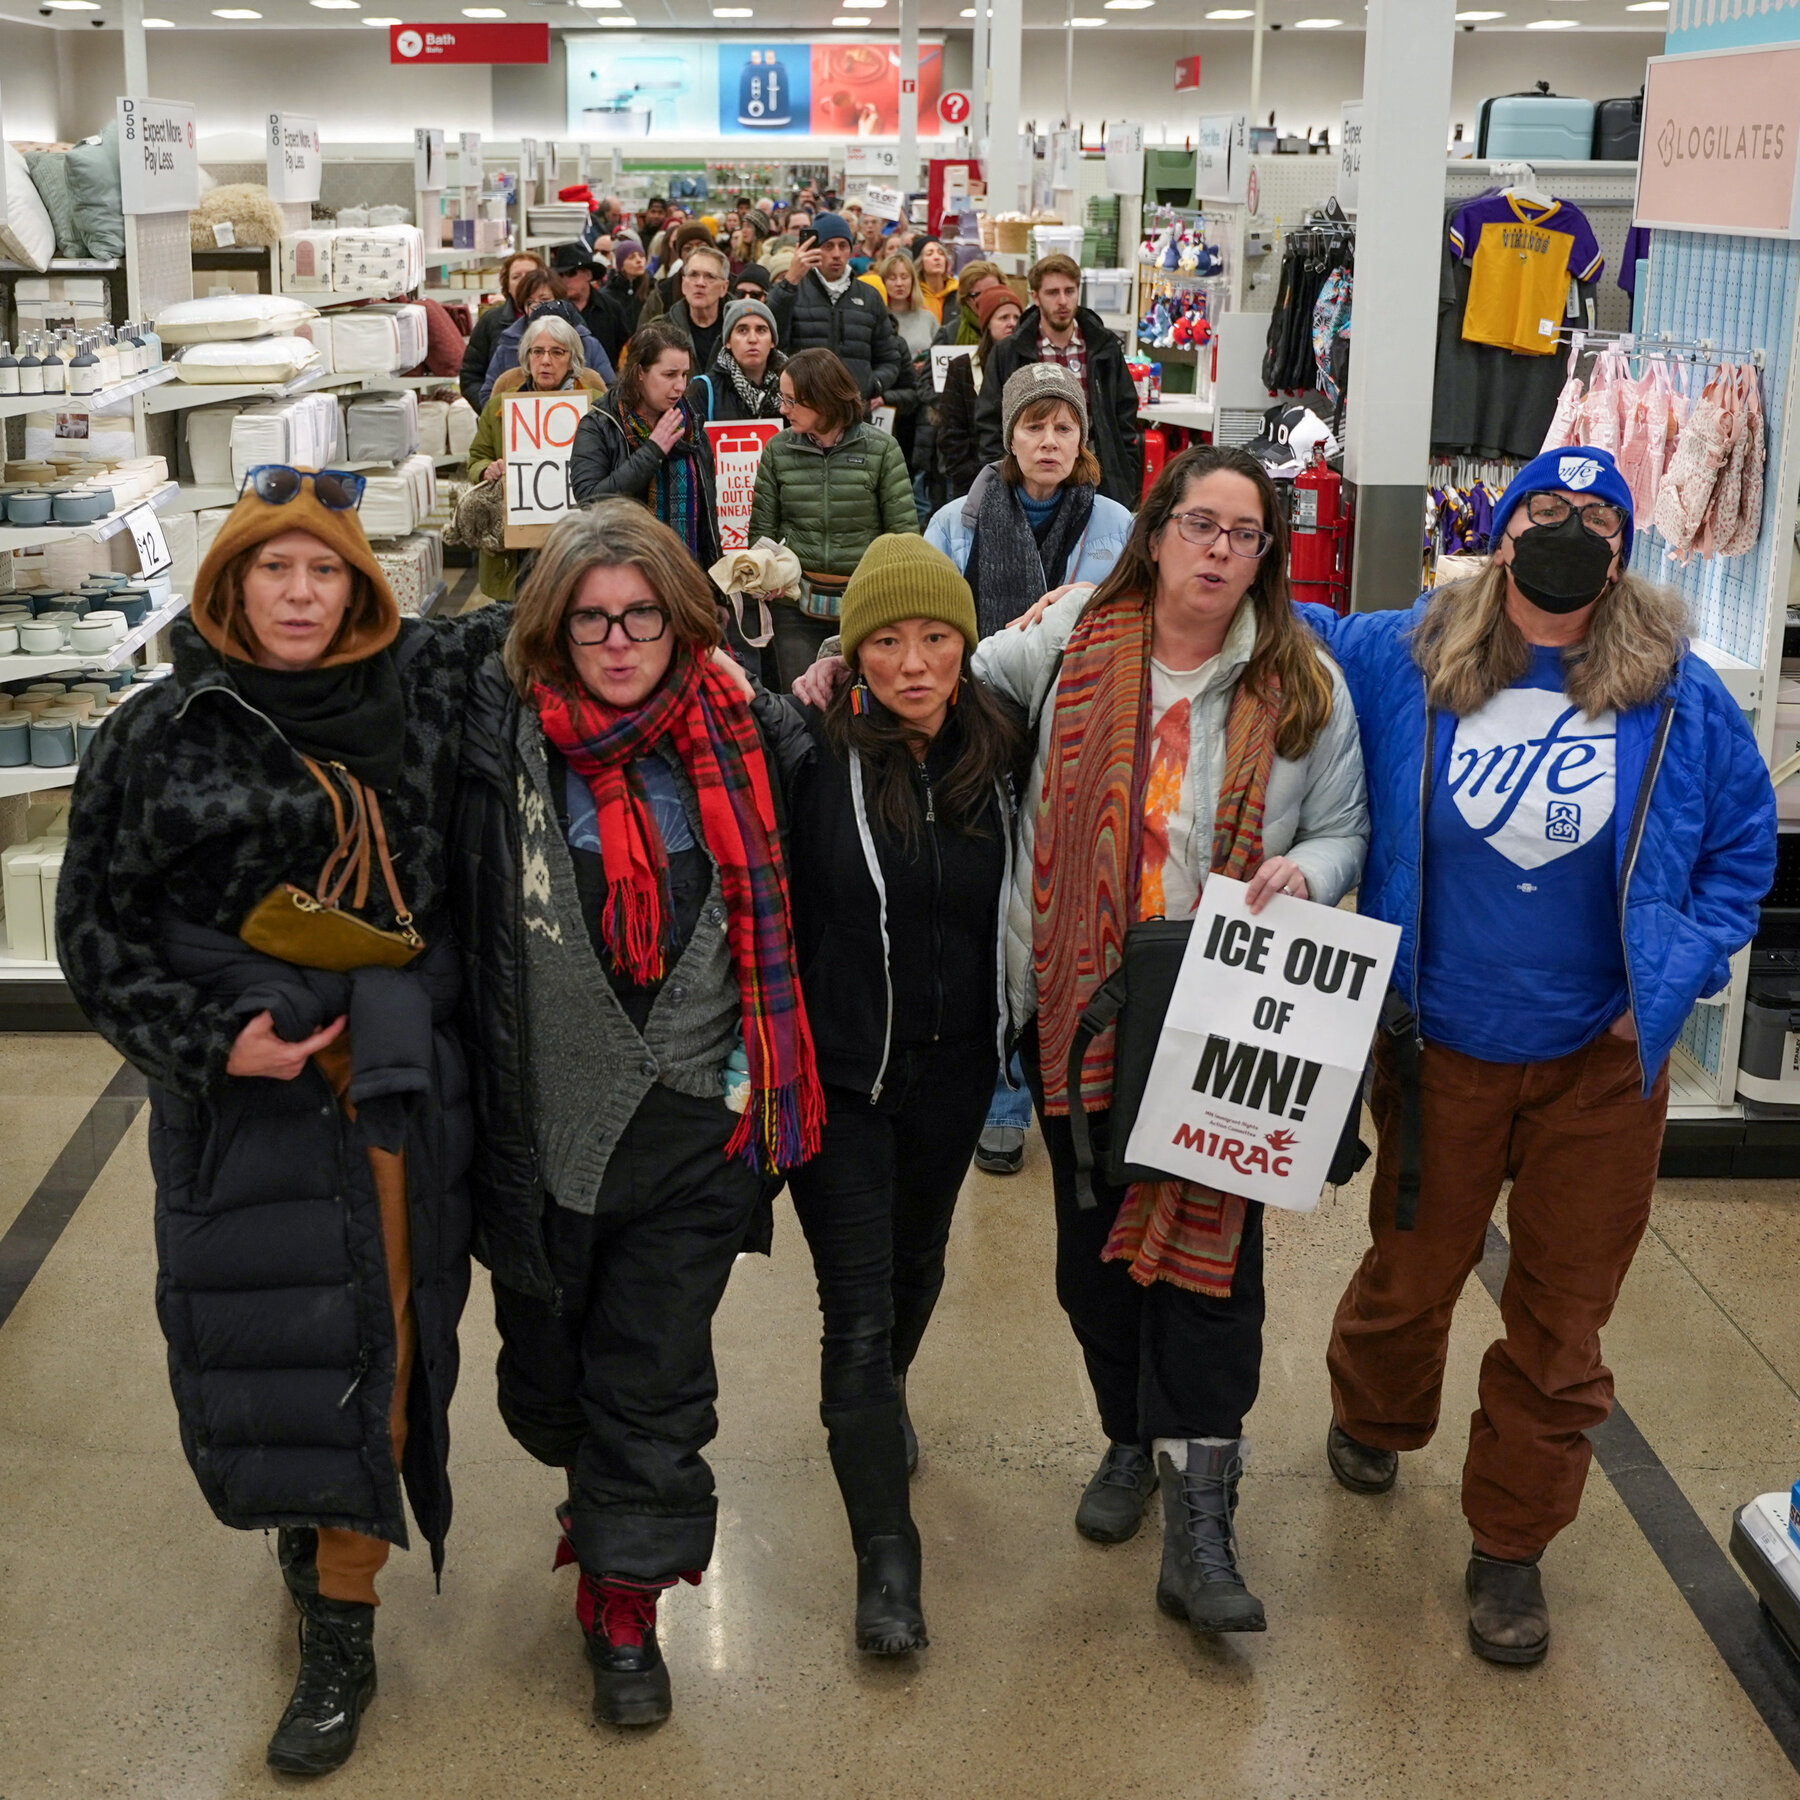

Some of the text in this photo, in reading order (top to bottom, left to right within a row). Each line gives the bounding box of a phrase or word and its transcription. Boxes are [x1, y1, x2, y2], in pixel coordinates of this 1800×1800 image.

[425, 33, 456, 45] Bath
[143, 117, 166, 147] Expect
[1344, 120, 1362, 150] Expec
[144, 146, 157, 176] Pay
[511, 399, 580, 452] NO
[871, 416, 884, 427] UT
[722, 490, 755, 503] OUT O
[1450, 704, 1617, 839] mfe
[1553, 822, 1573, 836] 59
[1203, 914, 1378, 1001] ICE OUT
[1252, 996, 1295, 1035] OF
[1191, 1033, 1323, 1122] MN!
[1209, 1120, 1257, 1138] Action Committee
[1171, 1122, 1293, 1178] MIRAC
